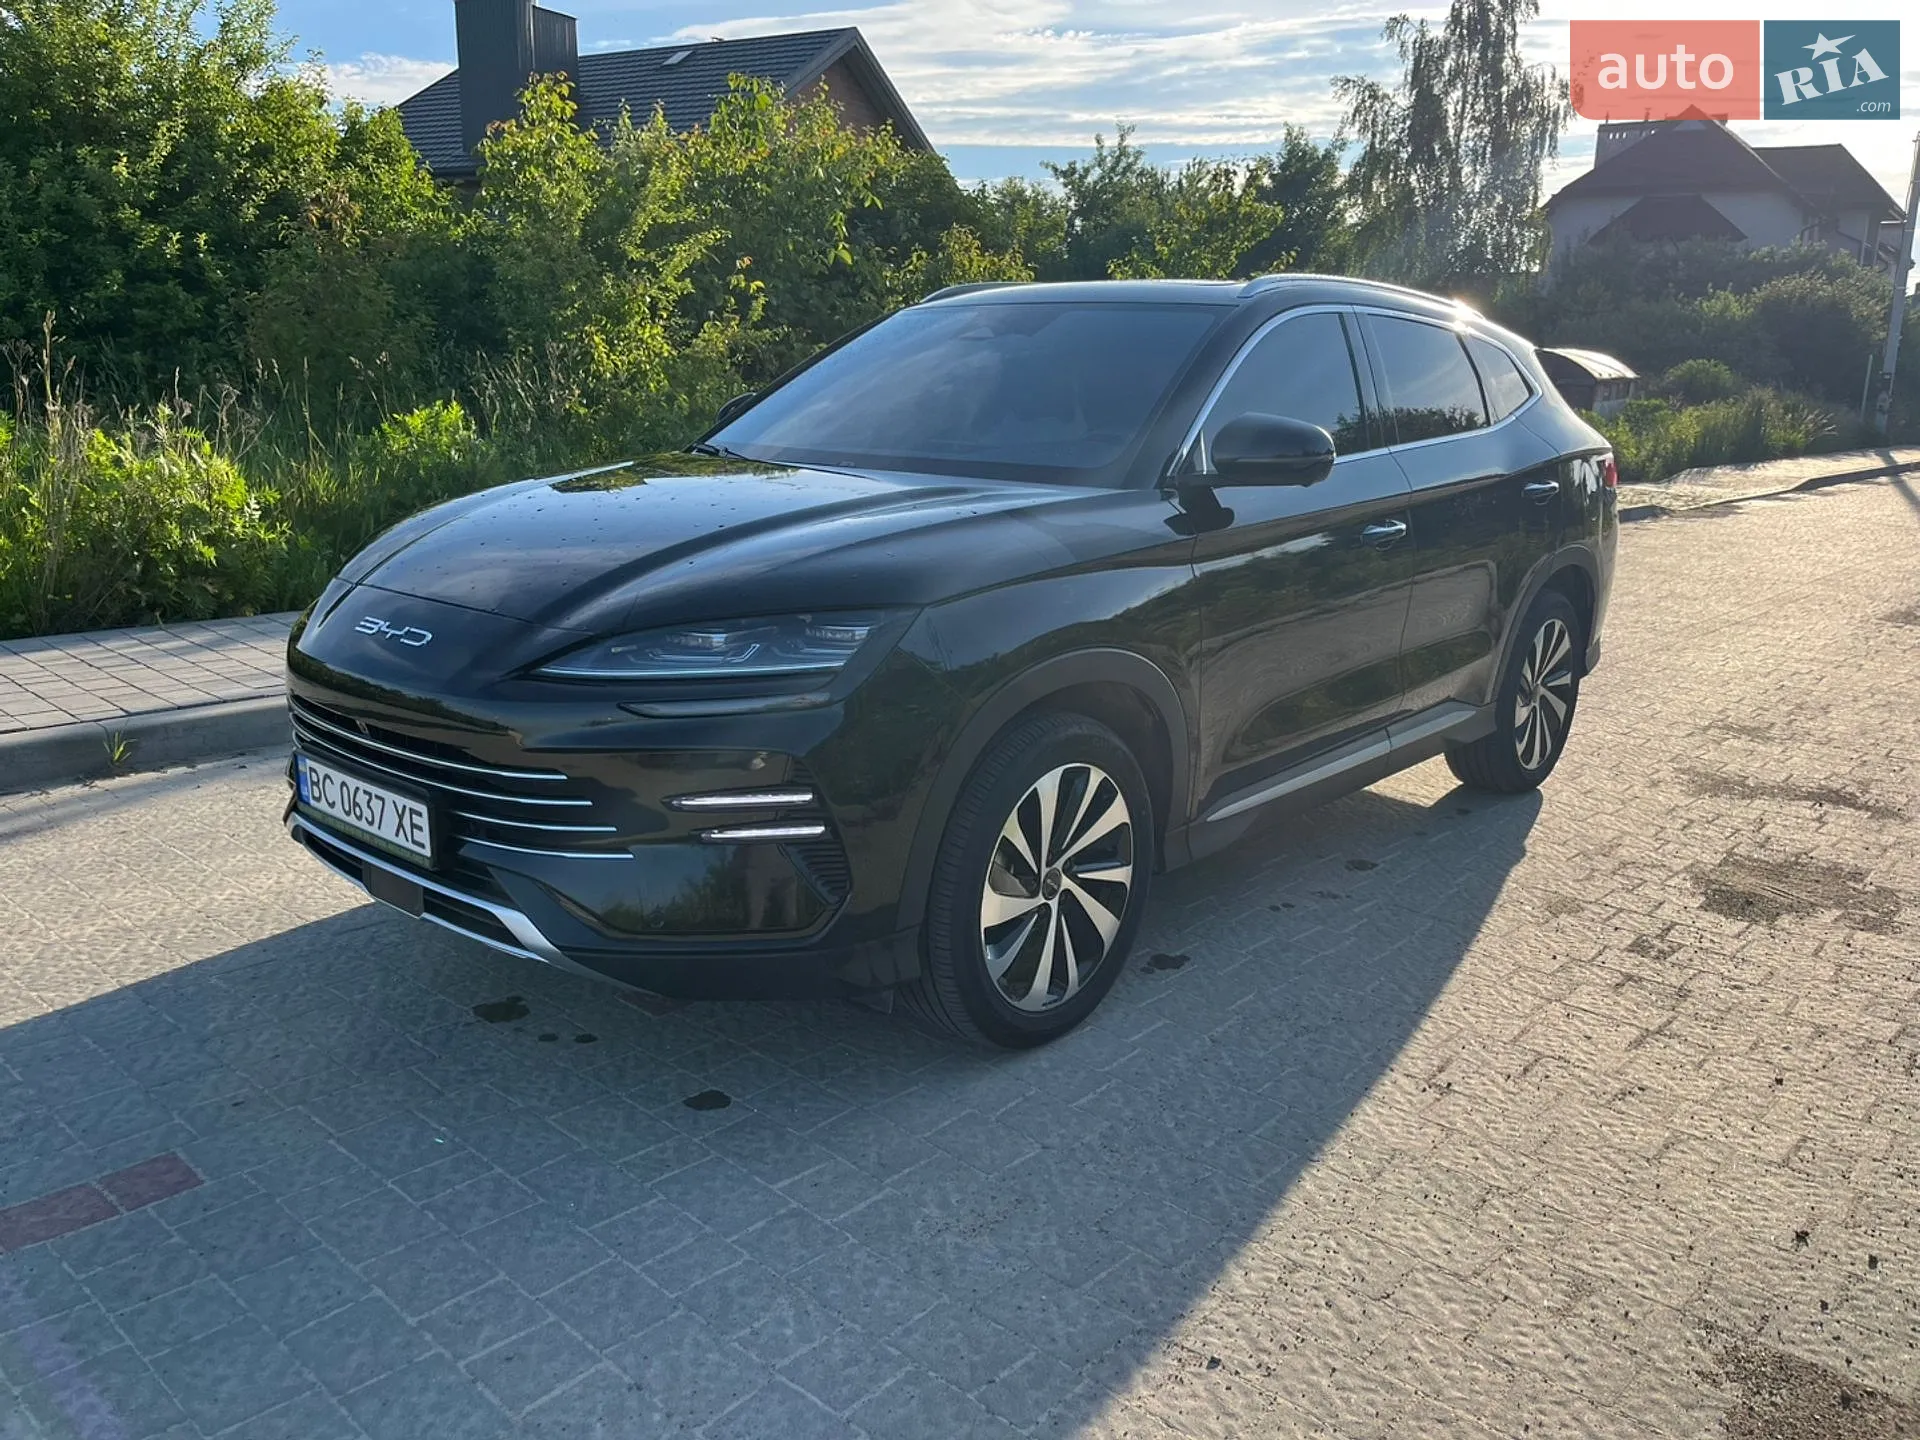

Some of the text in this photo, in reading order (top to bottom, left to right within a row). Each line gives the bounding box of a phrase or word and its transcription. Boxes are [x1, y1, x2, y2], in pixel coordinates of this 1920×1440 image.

[354, 616, 432, 646] BYD
[308, 767, 425, 849] BC 0637 XE
